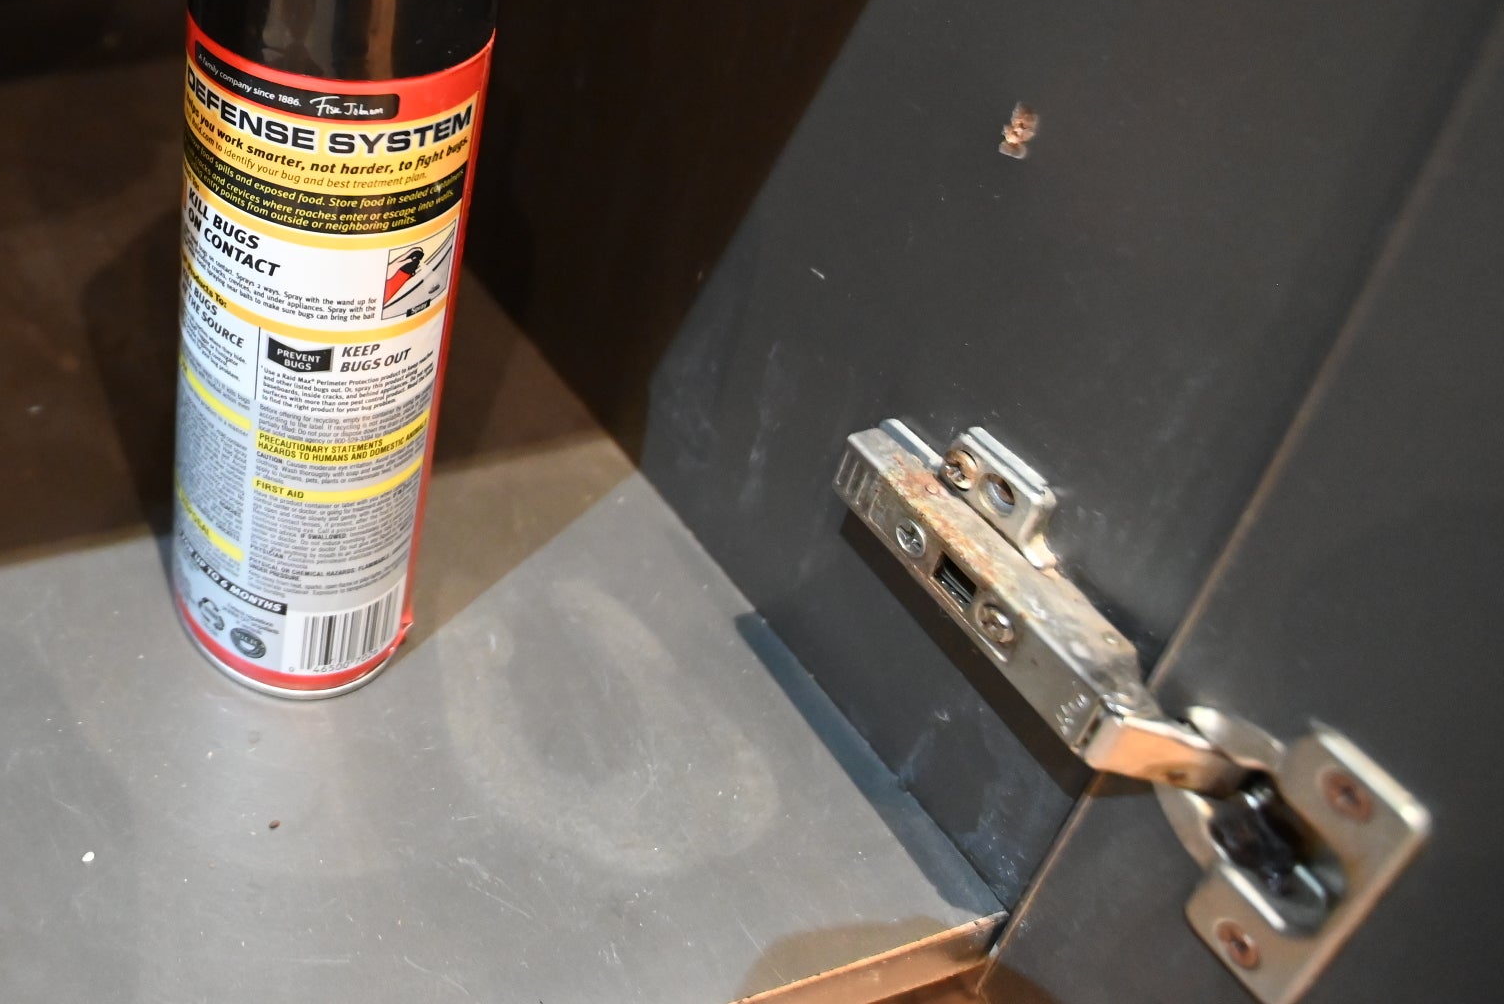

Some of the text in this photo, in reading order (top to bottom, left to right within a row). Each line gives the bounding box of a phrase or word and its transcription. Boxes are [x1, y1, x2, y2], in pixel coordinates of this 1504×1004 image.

[202, 56, 220, 75] family
[219, 71, 252, 93] company
[253, 87, 275, 100] since
[278, 94, 302, 107] 1886.
[188, 63, 473, 154] DEFENSE SYSTEM
[200, 113, 215, 132] you
[217, 127, 244, 150] work
[246, 145, 305, 171] smarter,
[310, 162, 337, 174] not
[340, 162, 394, 175] harder,
[398, 161, 413, 171] to
[414, 149, 445, 170] fight
[215, 142, 223, 152] to
[224, 146, 256, 170] identify
[257, 165, 280, 178] your
[280, 170, 301, 184] bug
[303, 177, 325, 187] and
[327, 178, 350, 189] best
[352, 176, 404, 189] treatment
[404, 172, 427, 185] plan.
[212, 172, 226, 186] and
[226, 182, 261, 204] crevices
[262, 198, 293, 214] where
[295, 207, 337, 221] roaches
[339, 212, 368, 222] enter
[369, 212, 381, 221] or
[382, 205, 417, 220] escape
[417, 199, 435, 212] into
[214, 159, 234, 178] spills
[235, 172, 253, 187] and
[254, 179, 297, 200] exposed
[297, 193, 326, 206] food.
[329, 197, 358, 208] Store
[359, 196, 385, 210] food
[386, 195, 397, 205] in
[398, 187, 429, 204] sealed
[189, 187, 209, 221] KILL
[213, 214, 260, 249] BUGS
[203, 174, 220, 193] entry
[220, 188, 246, 207] points
[246, 201, 269, 216] from
[270, 211, 310, 227] outside
[311, 220, 324, 229] or
[325, 220, 390, 233] neighboring
[391, 216, 417, 228] units.
[188, 207, 202, 232] ON
[204, 227, 281, 277] CONTACT
[193, 287, 218, 316] BUGS
[226, 283, 238, 293] near
[239, 290, 254, 302] baits
[263, 300, 280, 311] make
[281, 307, 296, 315] sure
[298, 310, 314, 319] bugs
[330, 314, 348, 322] bring
[228, 277, 251, 294] crevices,
[253, 290, 265, 299] and
[266, 294, 285, 304] under
[287, 301, 325, 312] appliances.
[327, 306, 347, 315] Spray
[349, 305, 364, 313] with
[236, 272, 255, 287] Sprays
[263, 286, 281, 296] ways.
[284, 291, 303, 302] Spray
[305, 296, 320, 304] with
[357, 299, 365, 307] up
[188, 292, 200, 315] THE
[201, 311, 245, 349] SOURCE
[276, 348, 321, 364] PREVENT
[283, 358, 312, 371] BUGS
[340, 357, 382, 373] BUGS
[383, 347, 412, 367] OUT
[341, 343, 381, 358] KEEP
[263, 368, 275, 376] Use
[282, 373, 296, 381] Raid
[349, 377, 379, 385] Protection
[263, 375, 275, 383] and
[276, 379, 292, 387] other
[294, 383, 312, 391] listed
[314, 385, 329, 393] bugs
[355, 385, 374, 393] spray
[263, 381, 298, 395] baseboards,
[262, 388, 288, 400] surfaces
[350, 399, 364, 407] pest
[269, 397, 281, 405] find
[294, 403, 309, 412] right
[258, 440, 297, 459] HAZARDS
[298, 452, 310, 461] TO
[312, 453, 349, 462] HUMANS
[350, 451, 368, 461] AND
[369, 436, 405, 457] DOMESTIC
[259, 432, 383, 454] PRECAUTIONARY STATEMENTS
[256, 479, 305, 499] FIRST AID
[229, 585, 283, 613] MONTHS
